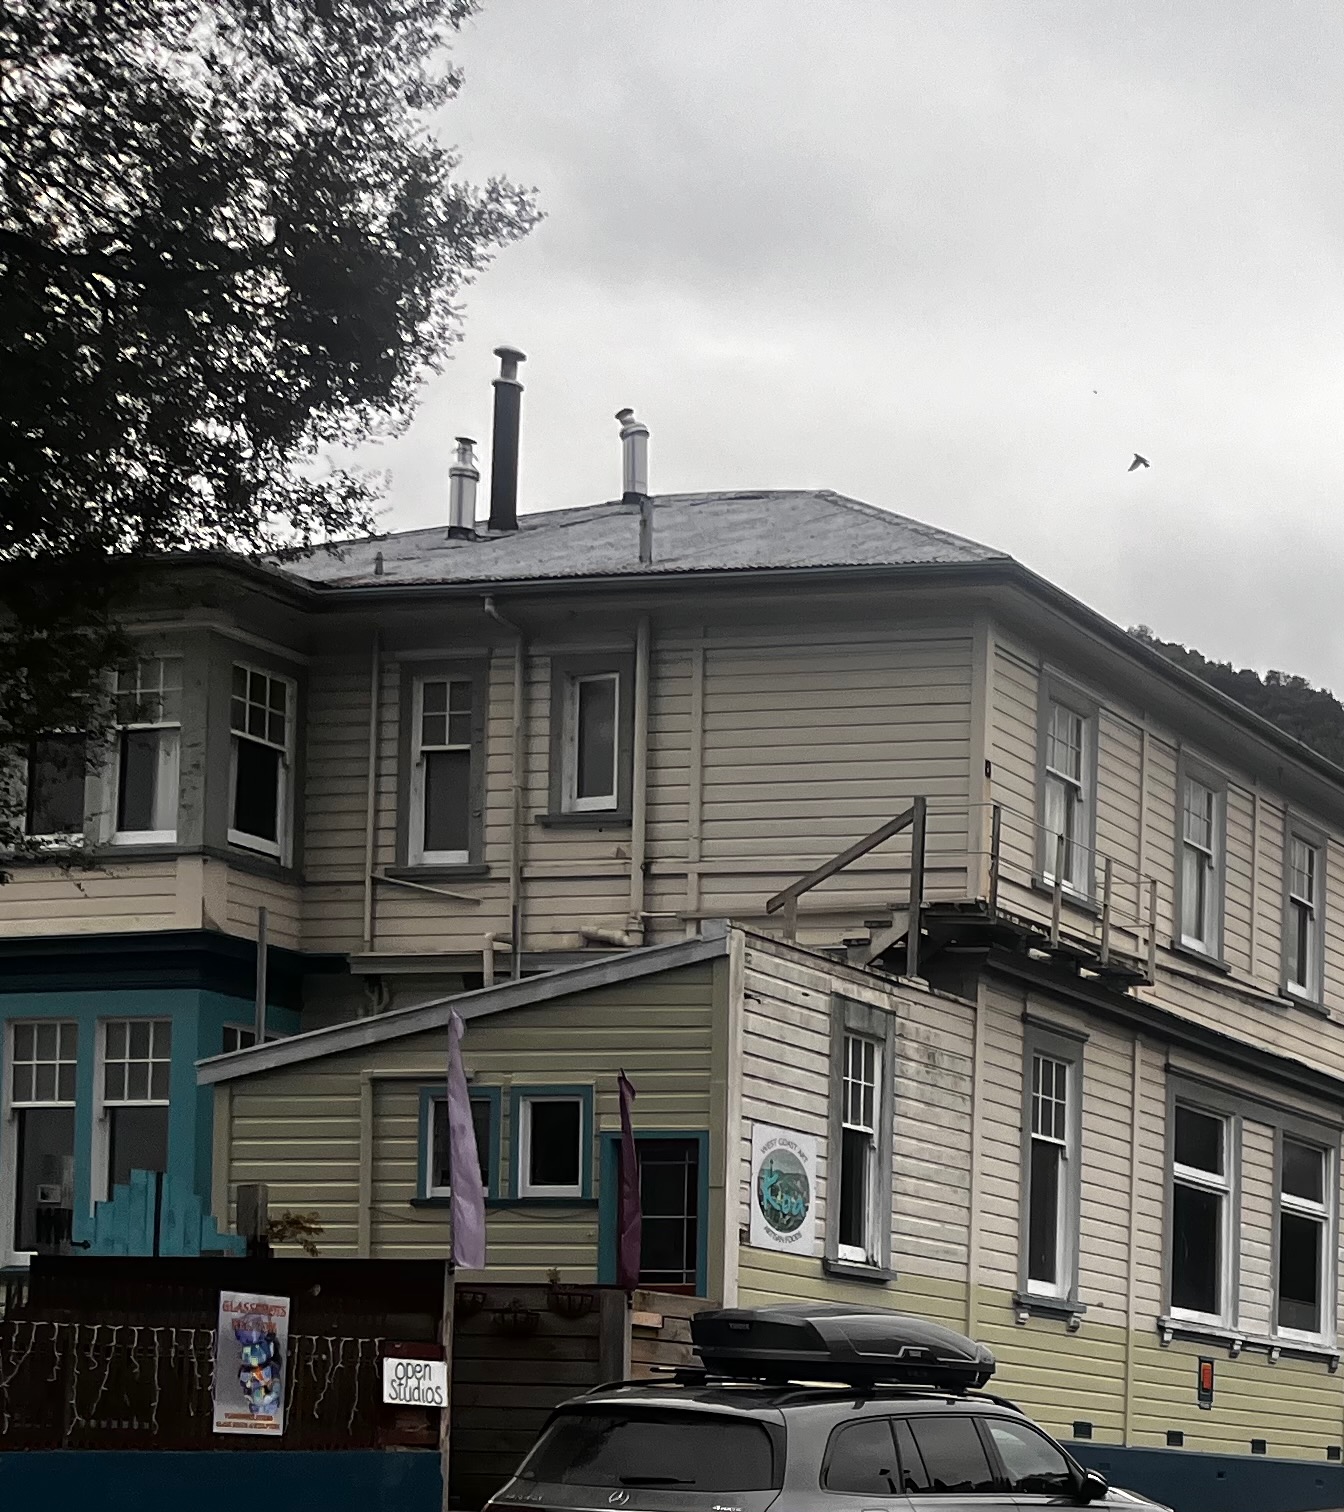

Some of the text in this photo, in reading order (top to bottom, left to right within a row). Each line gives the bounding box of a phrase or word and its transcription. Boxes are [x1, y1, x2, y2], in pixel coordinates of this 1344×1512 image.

[761, 1138, 777, 1154] WEST
[778, 1137, 798, 1152] COAST
[395, 1362, 431, 1387] open
[389, 1379, 443, 1405] Studios
